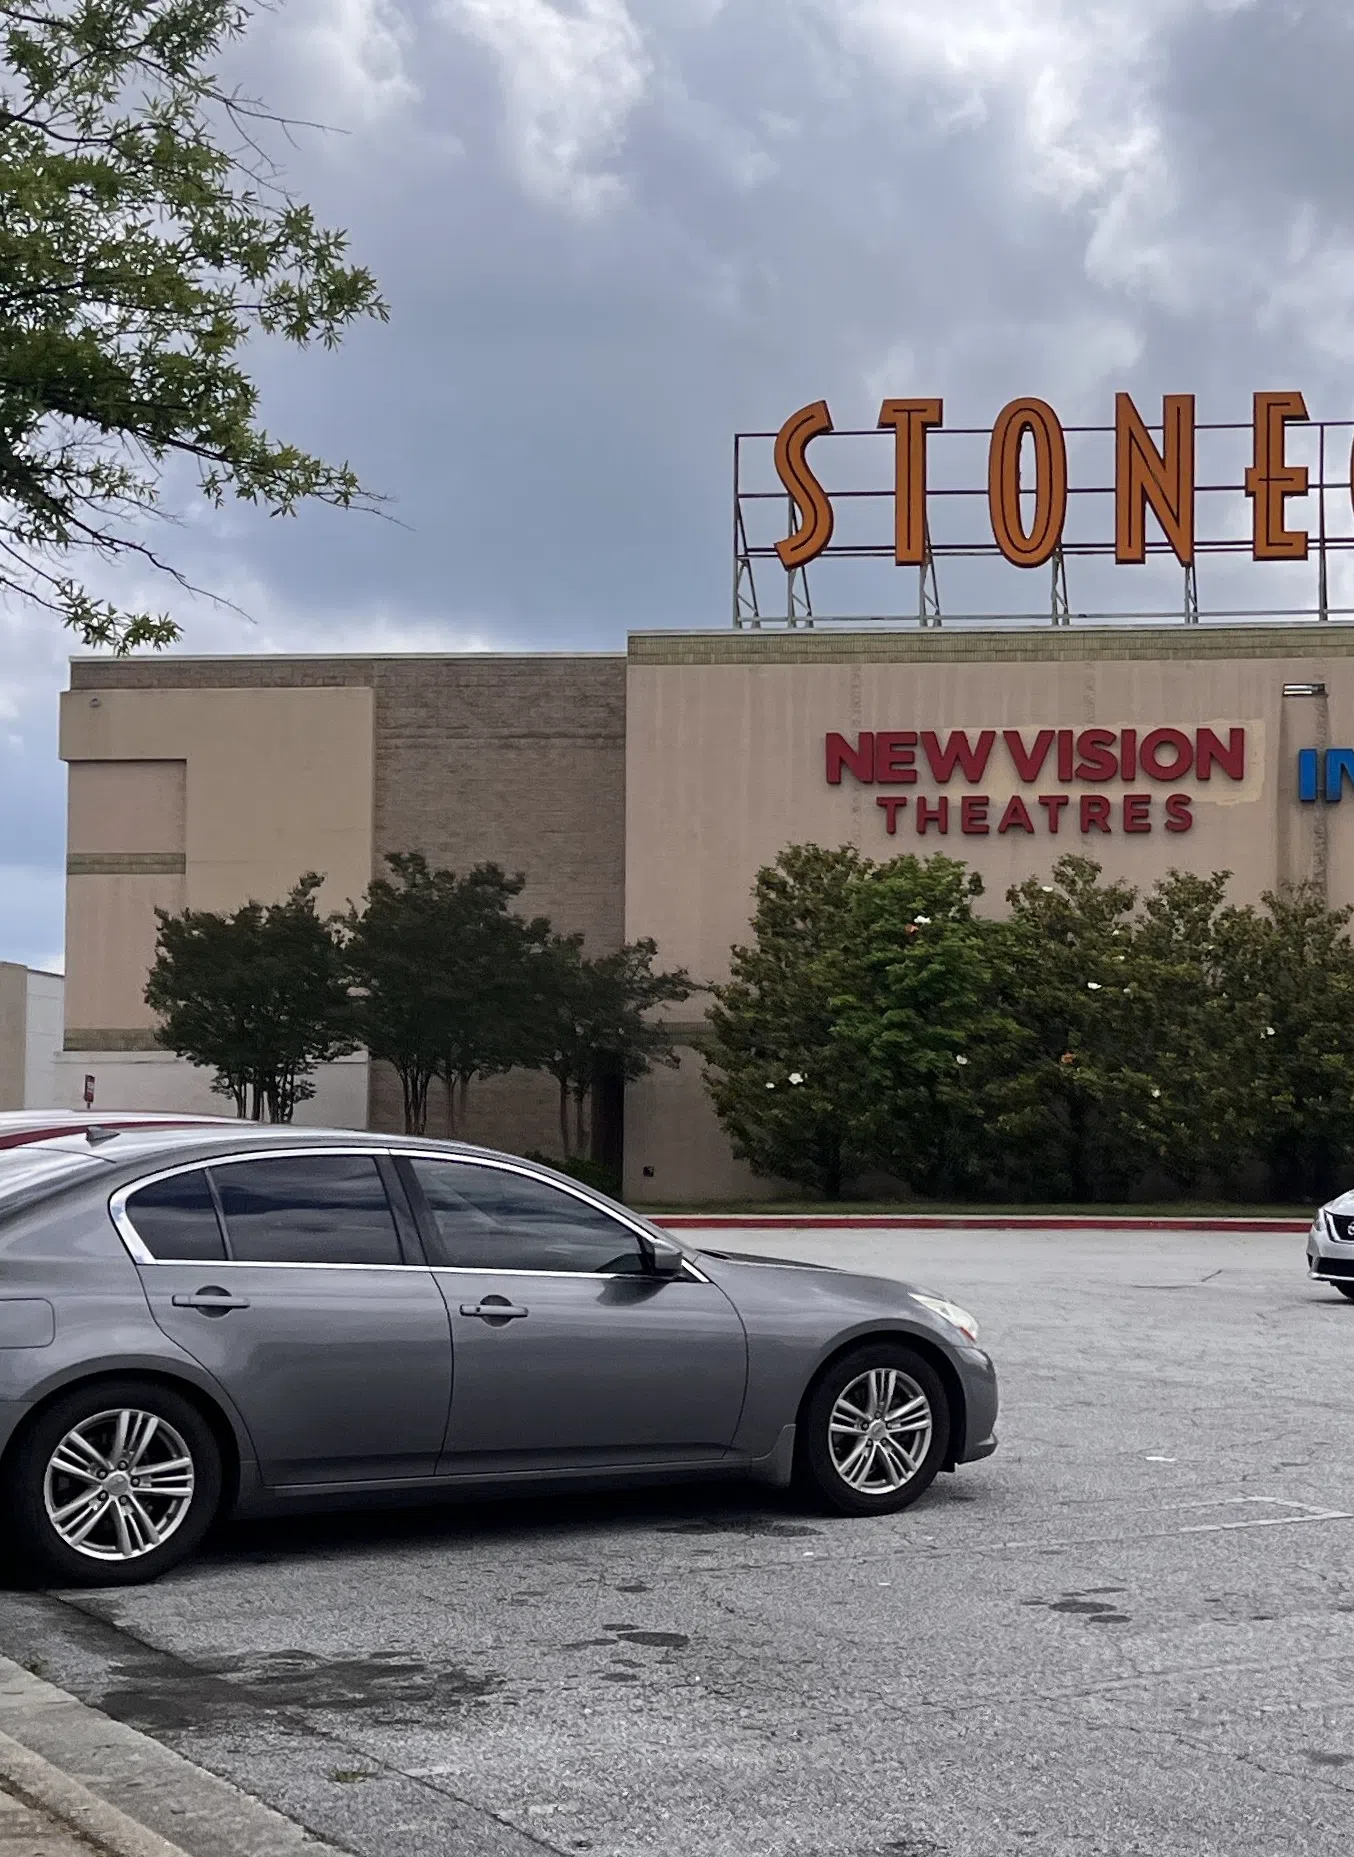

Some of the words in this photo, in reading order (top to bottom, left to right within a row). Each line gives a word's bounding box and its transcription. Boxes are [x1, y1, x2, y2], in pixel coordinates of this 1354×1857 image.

[825, 730, 997, 785] NEW
[1003, 727, 1246, 783] VISION
[876, 793, 1194, 835] THEATRES
